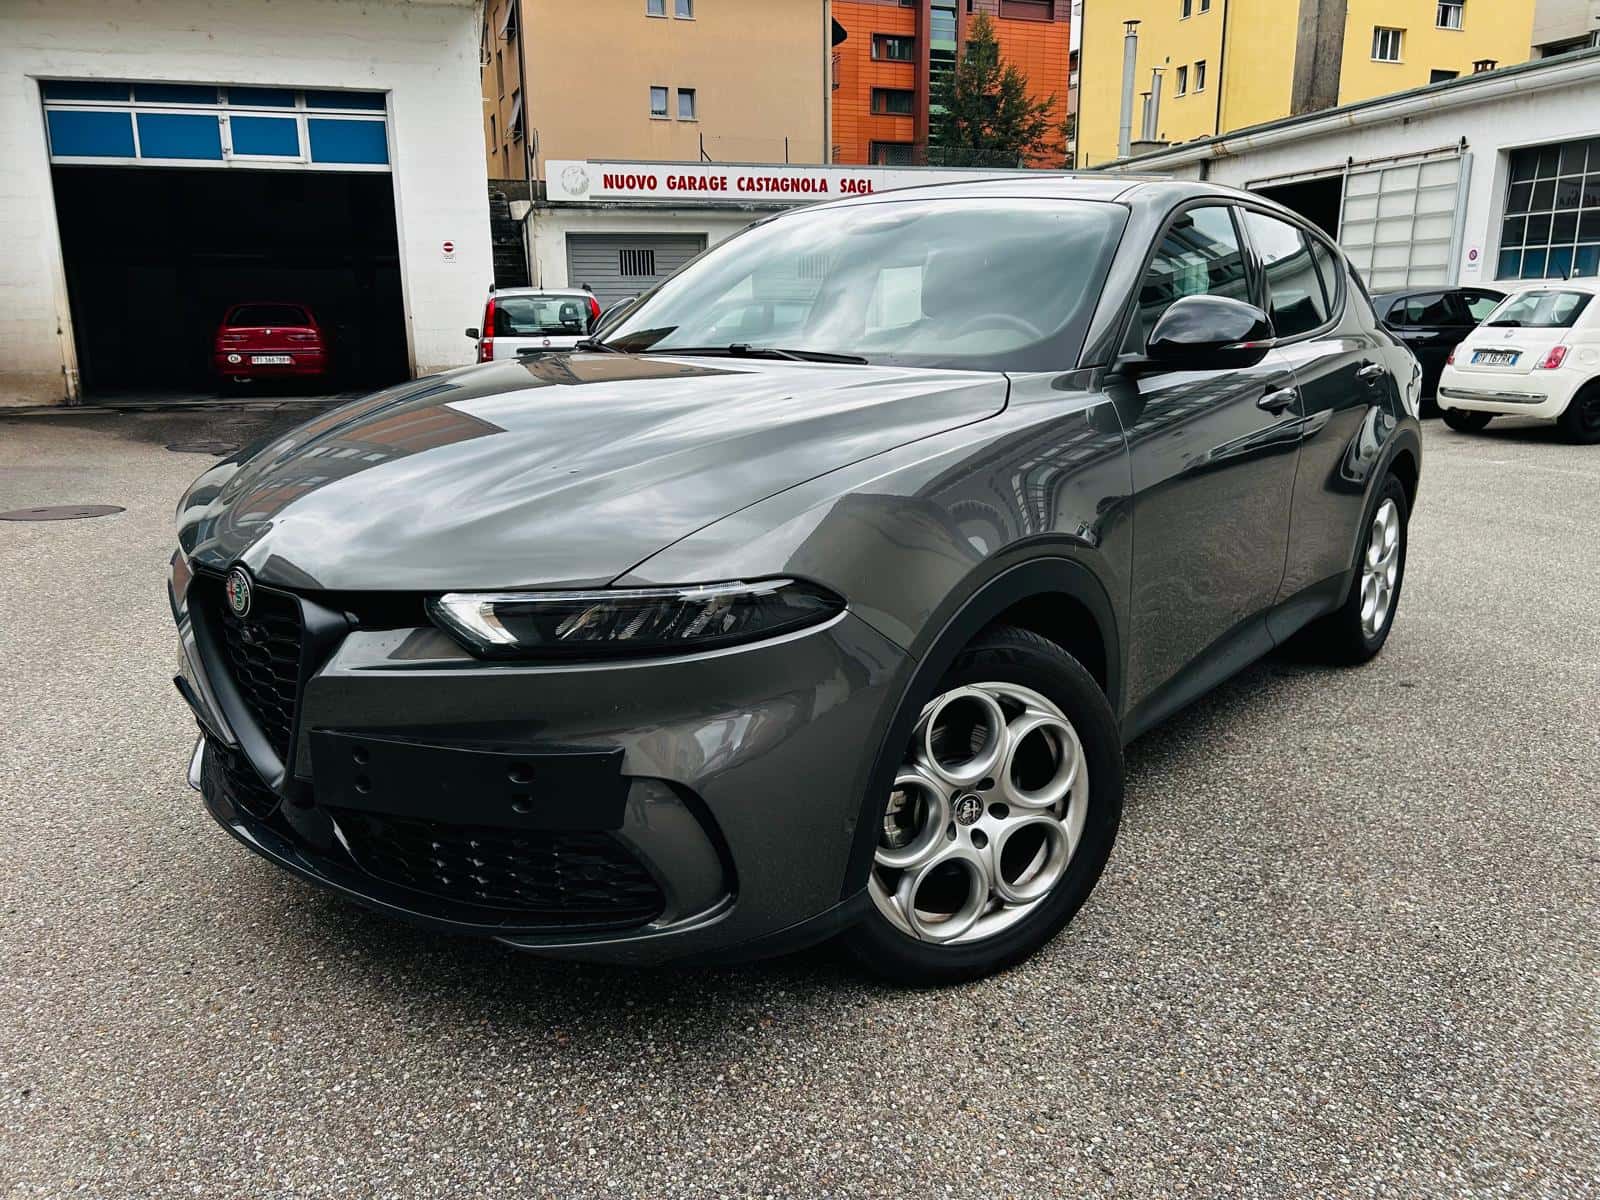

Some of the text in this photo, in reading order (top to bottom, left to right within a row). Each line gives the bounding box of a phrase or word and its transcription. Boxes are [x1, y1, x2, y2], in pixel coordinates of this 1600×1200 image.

[603, 174, 874, 193] NUOVO GARAGE CASTAGNOLA SAGL
